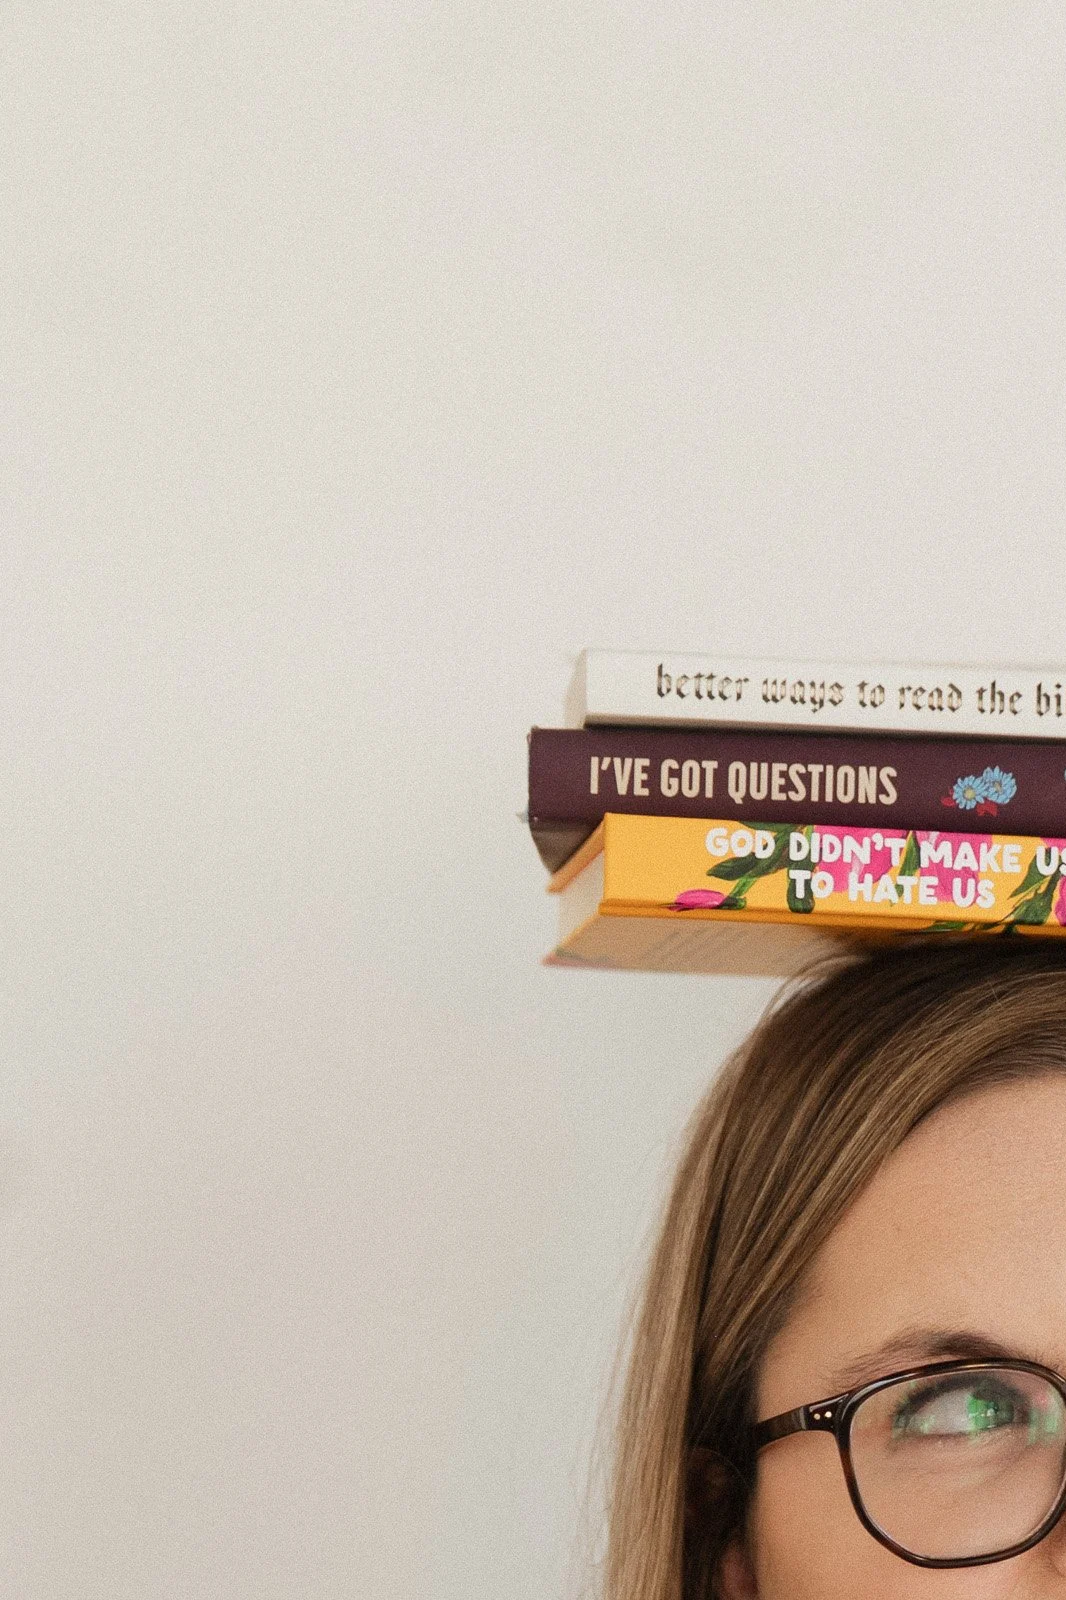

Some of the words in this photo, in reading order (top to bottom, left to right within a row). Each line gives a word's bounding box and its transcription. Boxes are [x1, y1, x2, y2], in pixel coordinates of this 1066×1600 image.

[656, 663, 749, 702] better
[761, 675, 845, 713] ways
[857, 680, 885, 708] to
[898, 681, 963, 712] read
[975, 679, 1022, 716] the
[589, 756, 650, 796] I'VE
[660, 758, 718, 798] GOT
[727, 760, 898, 805] QUESTIONS
[705, 827, 775, 860] GOD
[788, 832, 905, 867] DIDN'T
[919, 841, 1022, 873] MAKE
[788, 869, 834, 898] TO
[848, 875, 939, 907] HATE
[952, 878, 995, 909] US
